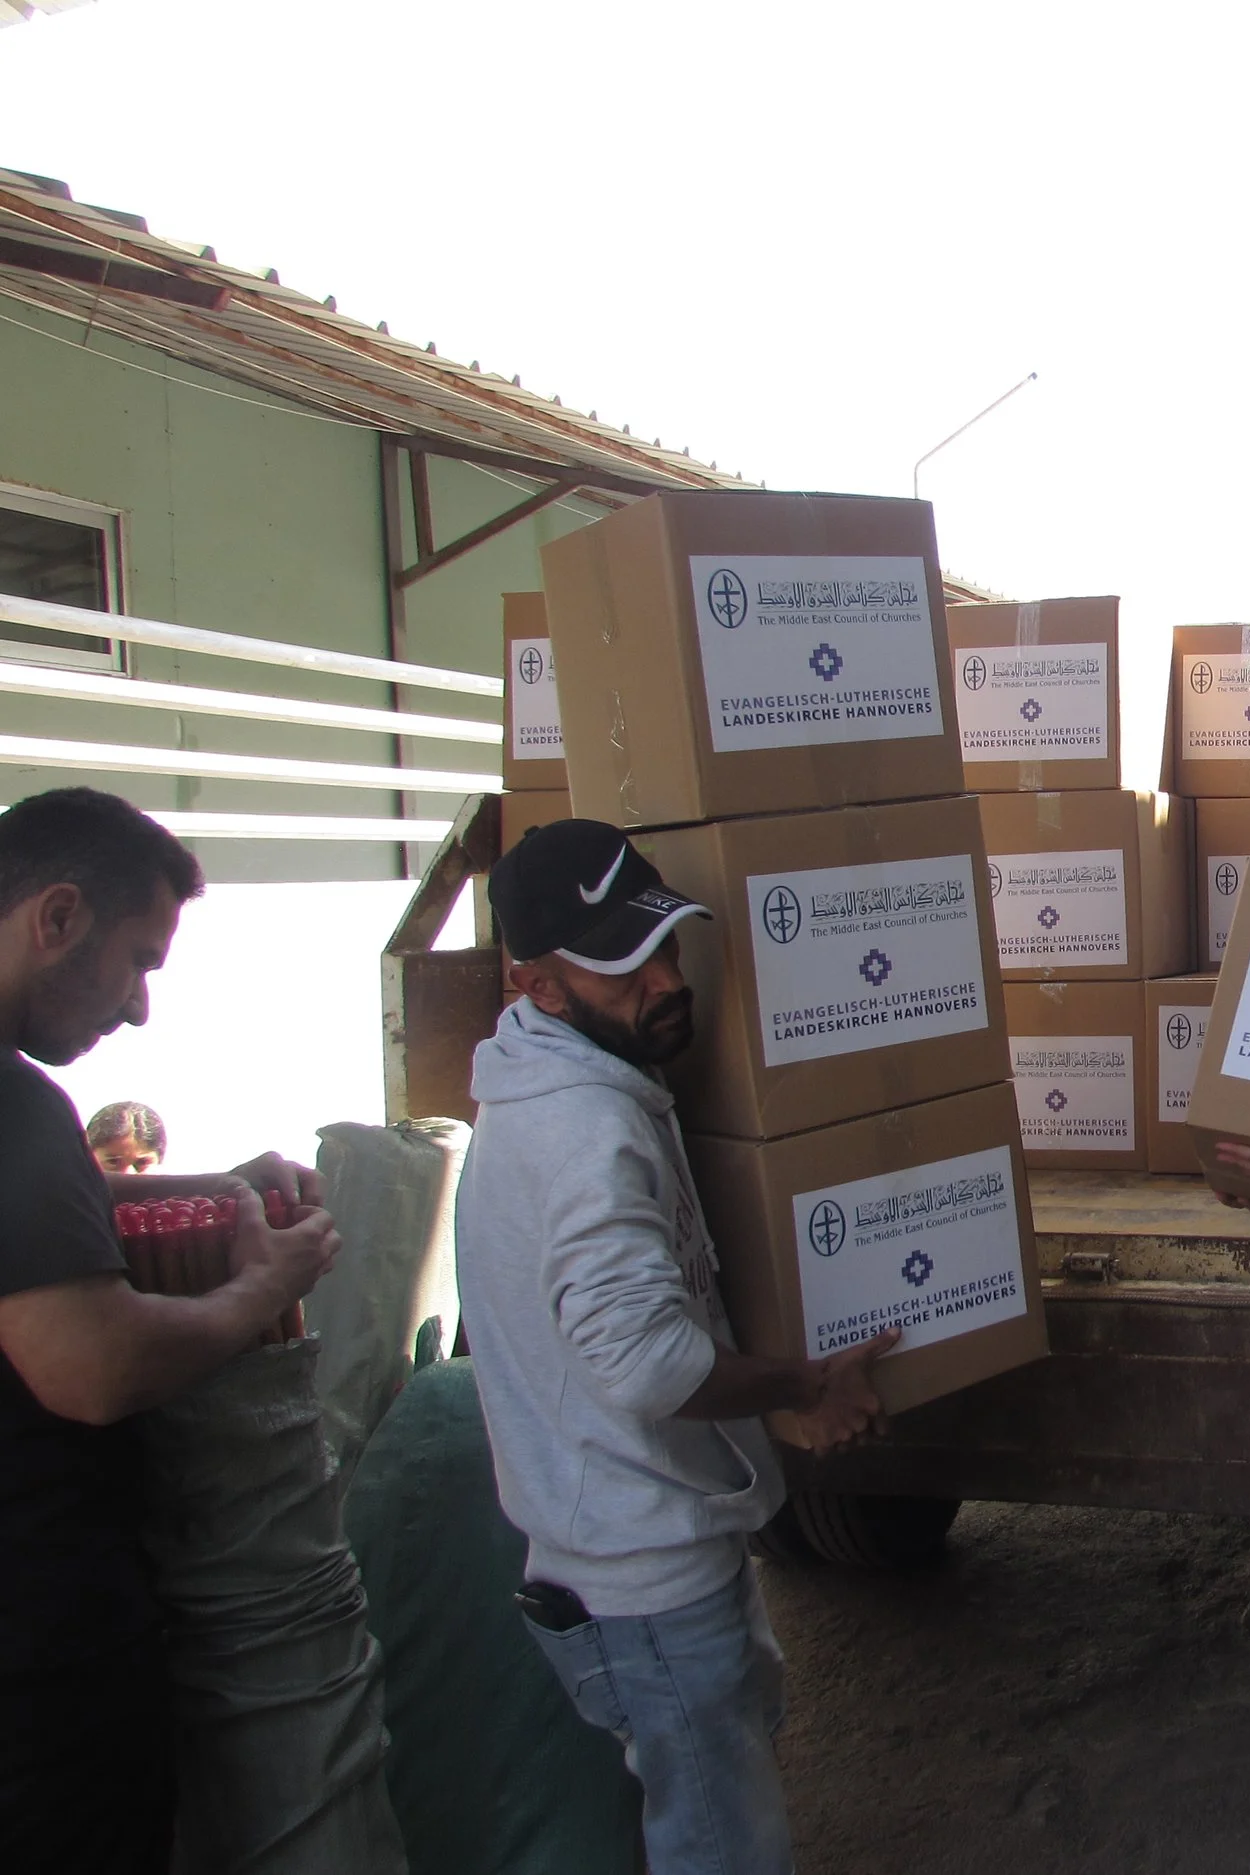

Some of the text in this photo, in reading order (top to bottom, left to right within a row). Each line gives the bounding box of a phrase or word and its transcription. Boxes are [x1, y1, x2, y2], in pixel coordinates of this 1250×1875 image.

[758, 613, 921, 626] The Middle East Council of Churches
[720, 688, 931, 711] EVANGELISCH-LUTHERISCHE
[723, 702, 932, 727] LANDESKIRCHE HANNOVERS
[964, 727, 1100, 739] EVANGELISCH-LUTHERISCHE
[964, 737, 1100, 748] LANDESKIRCHE HANNOVERS
[636, 892, 677, 909] NIKE
[811, 910, 968, 937] The Middle East Council of Churches
[1059, 944, 1120, 952] HANNOVERS
[773, 982, 976, 1025] EVANGELISCH-LUTHERISCHE
[775, 997, 977, 1041] LANDESKIRCHE HANNOVERS
[855, 1201, 1007, 1246] The Middle East Council of Churches
[817, 1271, 1014, 1336] EVANGELISCH-LUTHERISCHE
[935, 1285, 1016, 1318] HANNOVERS
